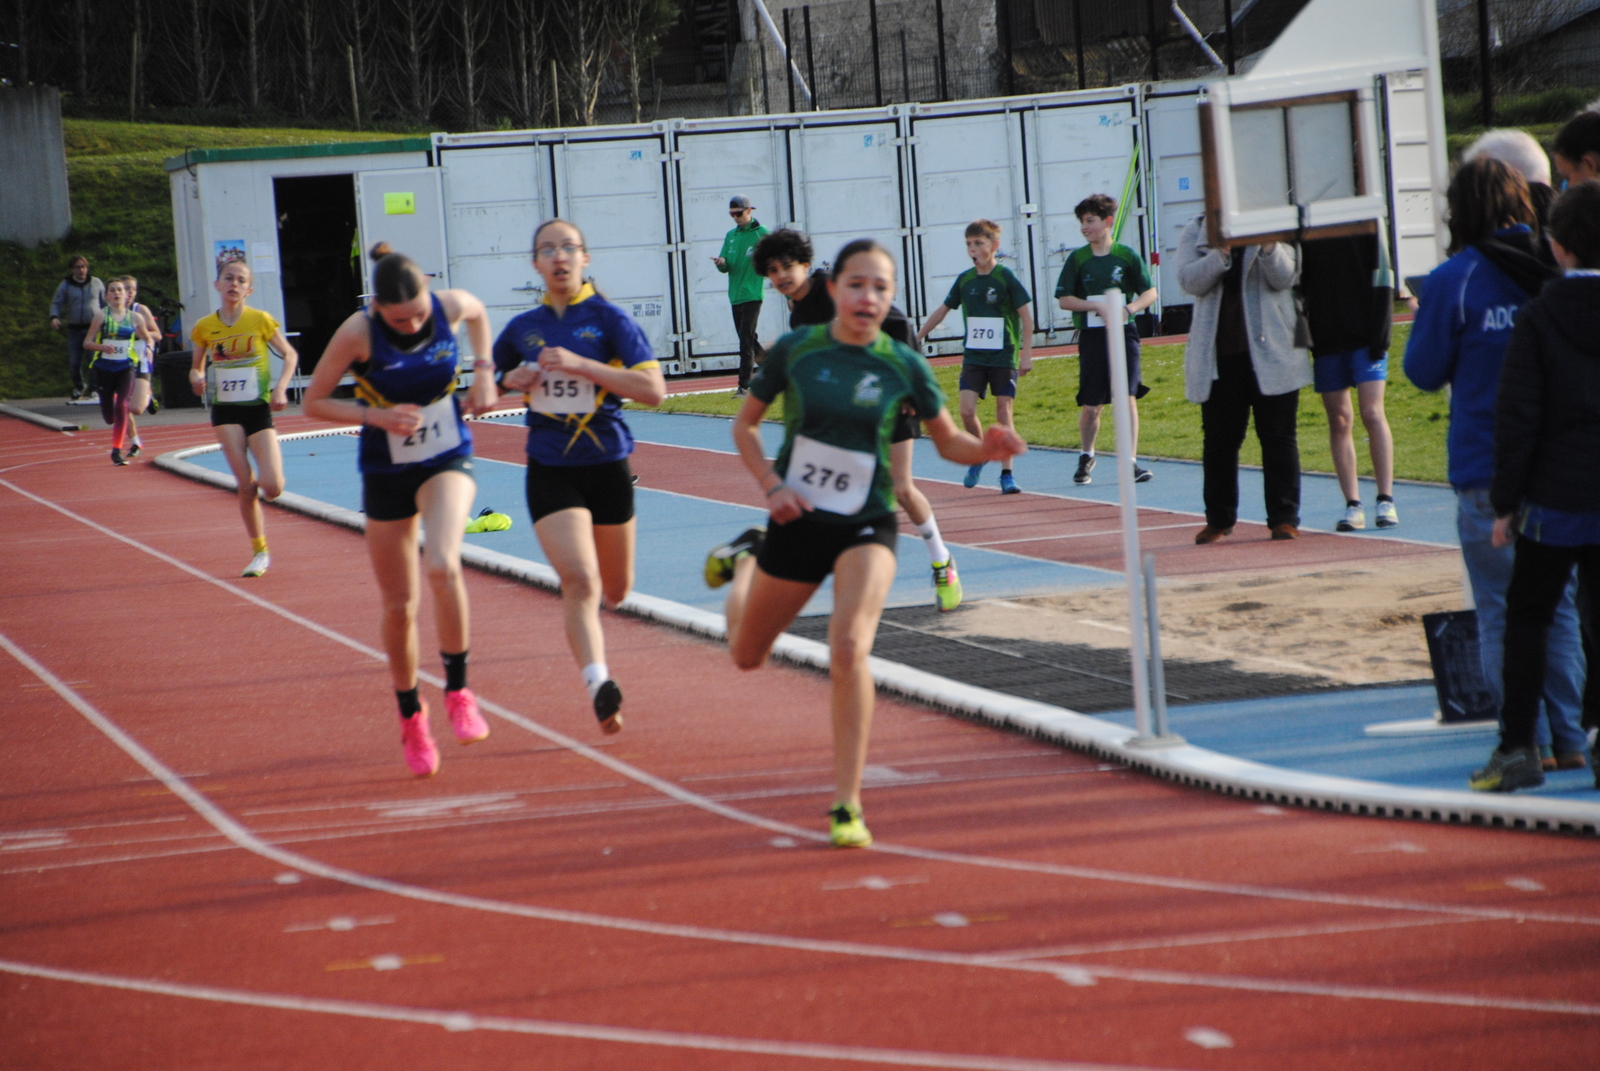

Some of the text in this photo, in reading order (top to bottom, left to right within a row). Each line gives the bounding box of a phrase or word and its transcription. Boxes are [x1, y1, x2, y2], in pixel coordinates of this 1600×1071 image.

[973, 328, 994, 339] 270
[222, 379, 247, 392] 277
[541, 380, 579, 398] 155
[802, 463, 850, 492] 276
